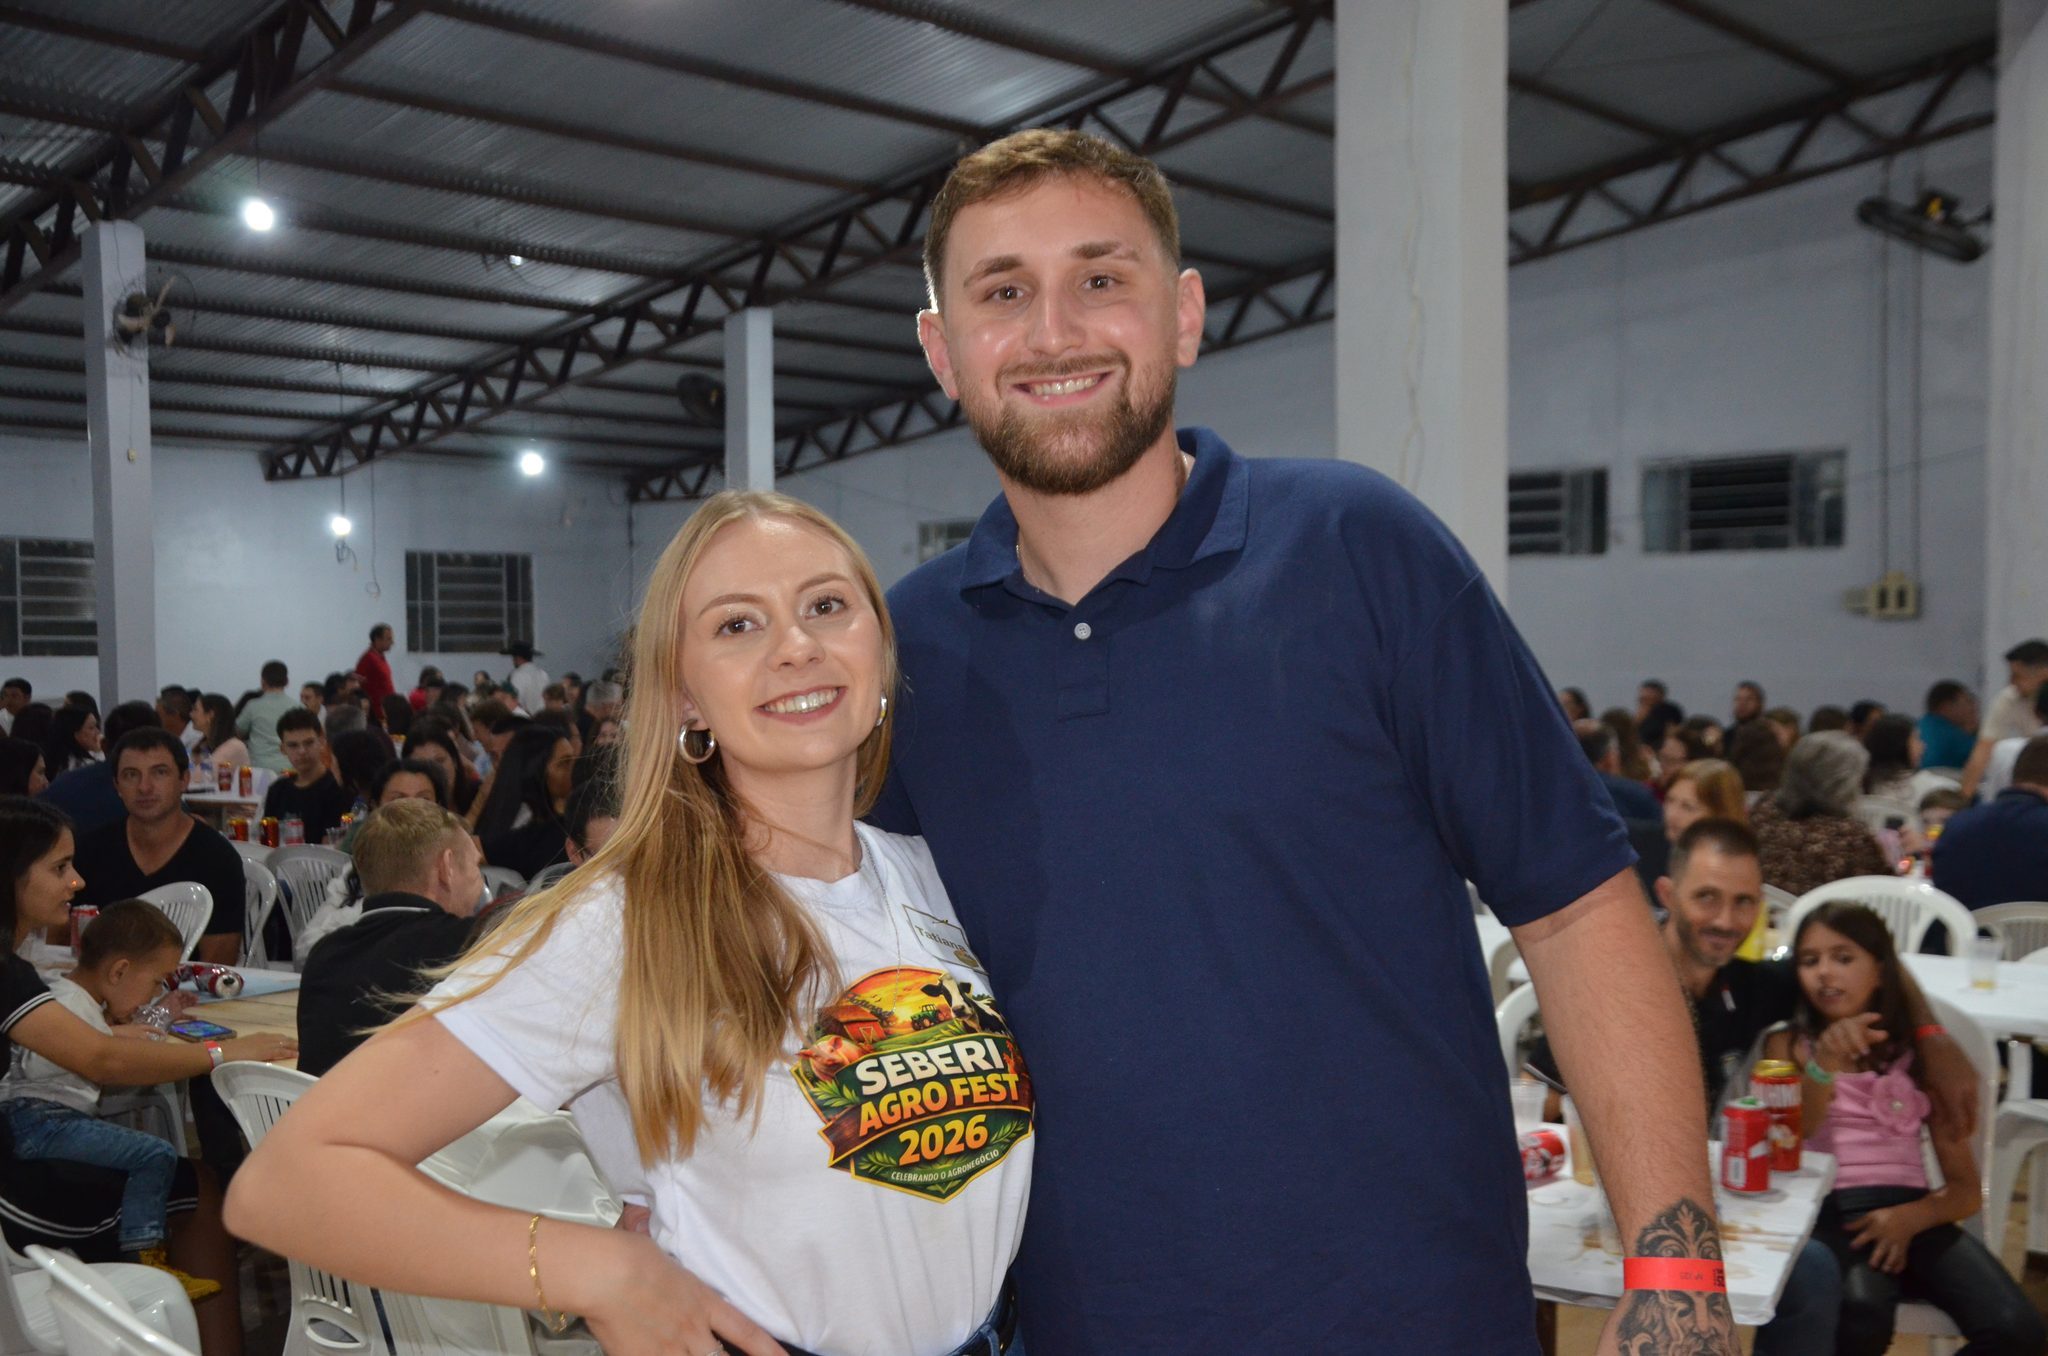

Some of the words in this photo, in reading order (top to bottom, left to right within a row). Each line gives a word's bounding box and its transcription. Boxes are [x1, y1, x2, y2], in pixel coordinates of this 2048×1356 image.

[855, 1038, 1005, 1096] SEBERI
[859, 1081, 948, 1137] AGRO
[950, 1073, 1019, 1106] FEST
[890, 1171, 939, 1182] CELEBRANDO
[940, 1172, 947, 1180] O
[947, 1149, 999, 1178] AGRONEGÓCIO
[898, 1114, 989, 1166] 2026
